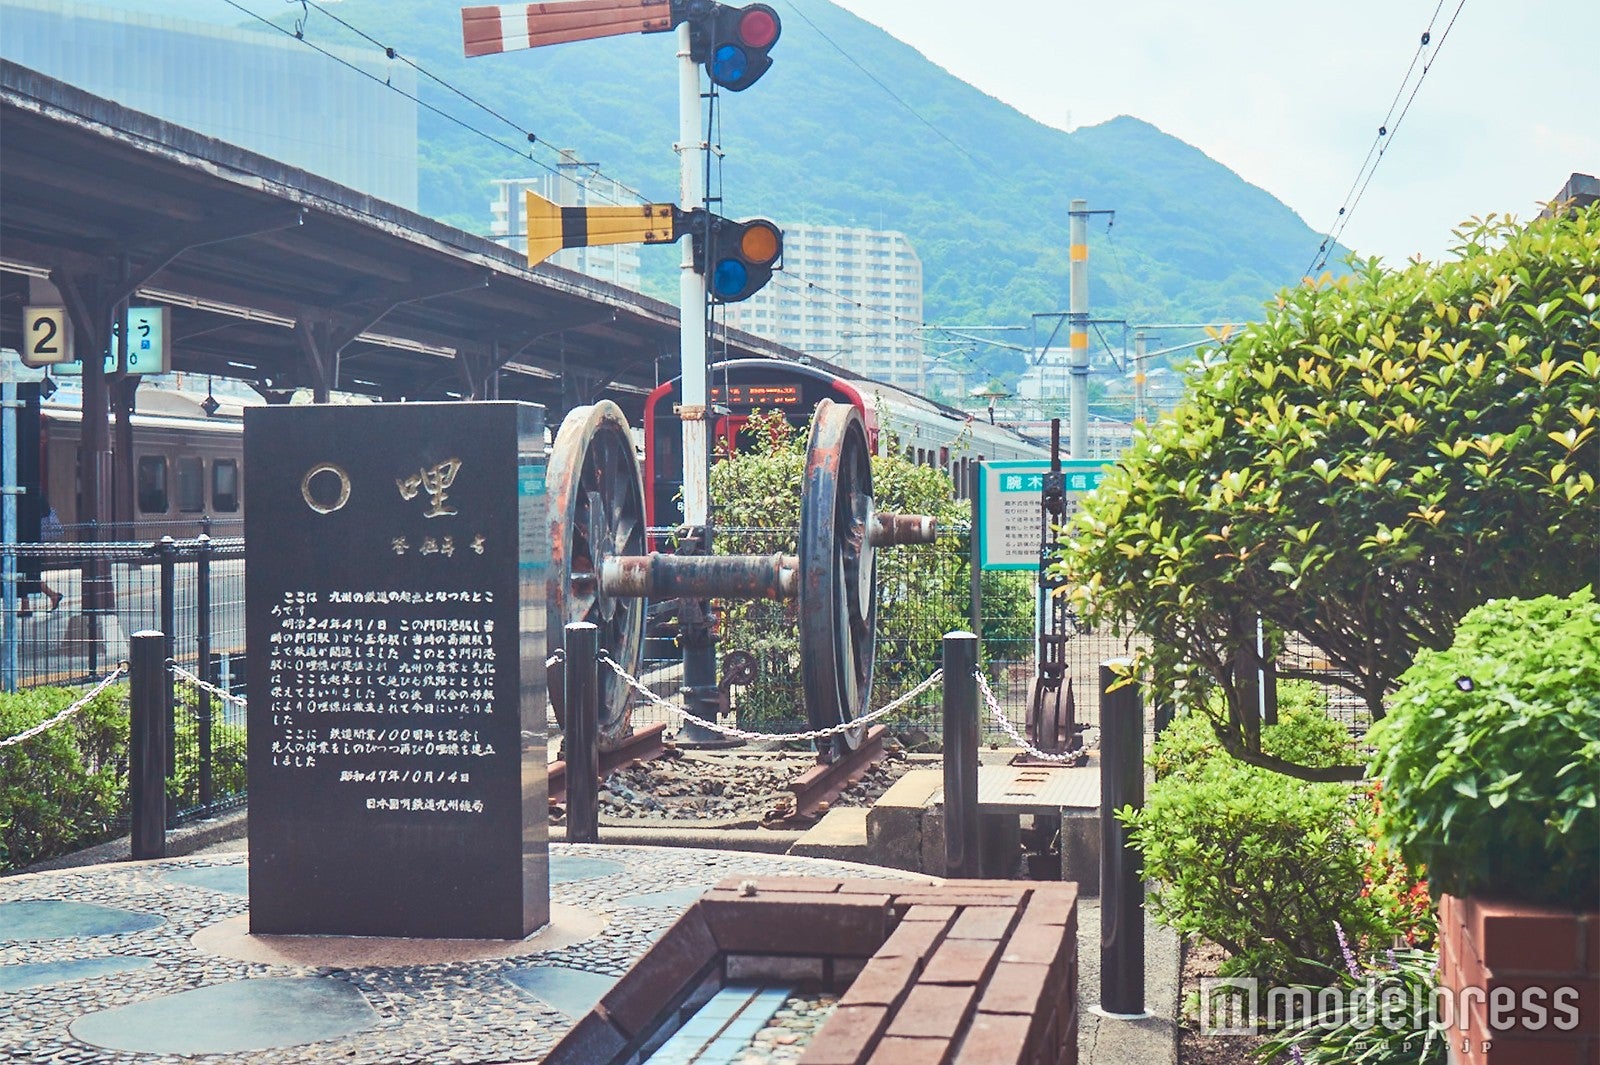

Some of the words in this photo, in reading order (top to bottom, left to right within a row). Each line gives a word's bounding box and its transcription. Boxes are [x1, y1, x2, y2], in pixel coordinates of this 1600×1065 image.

[33, 317, 58, 354] 2
[284, 591, 317, 604] ここは
[273, 714, 293, 726] した
[285, 729, 317, 740] ここに
[272, 755, 316, 767] しました
[339, 770, 470, 783] 昭和47年10月14日
